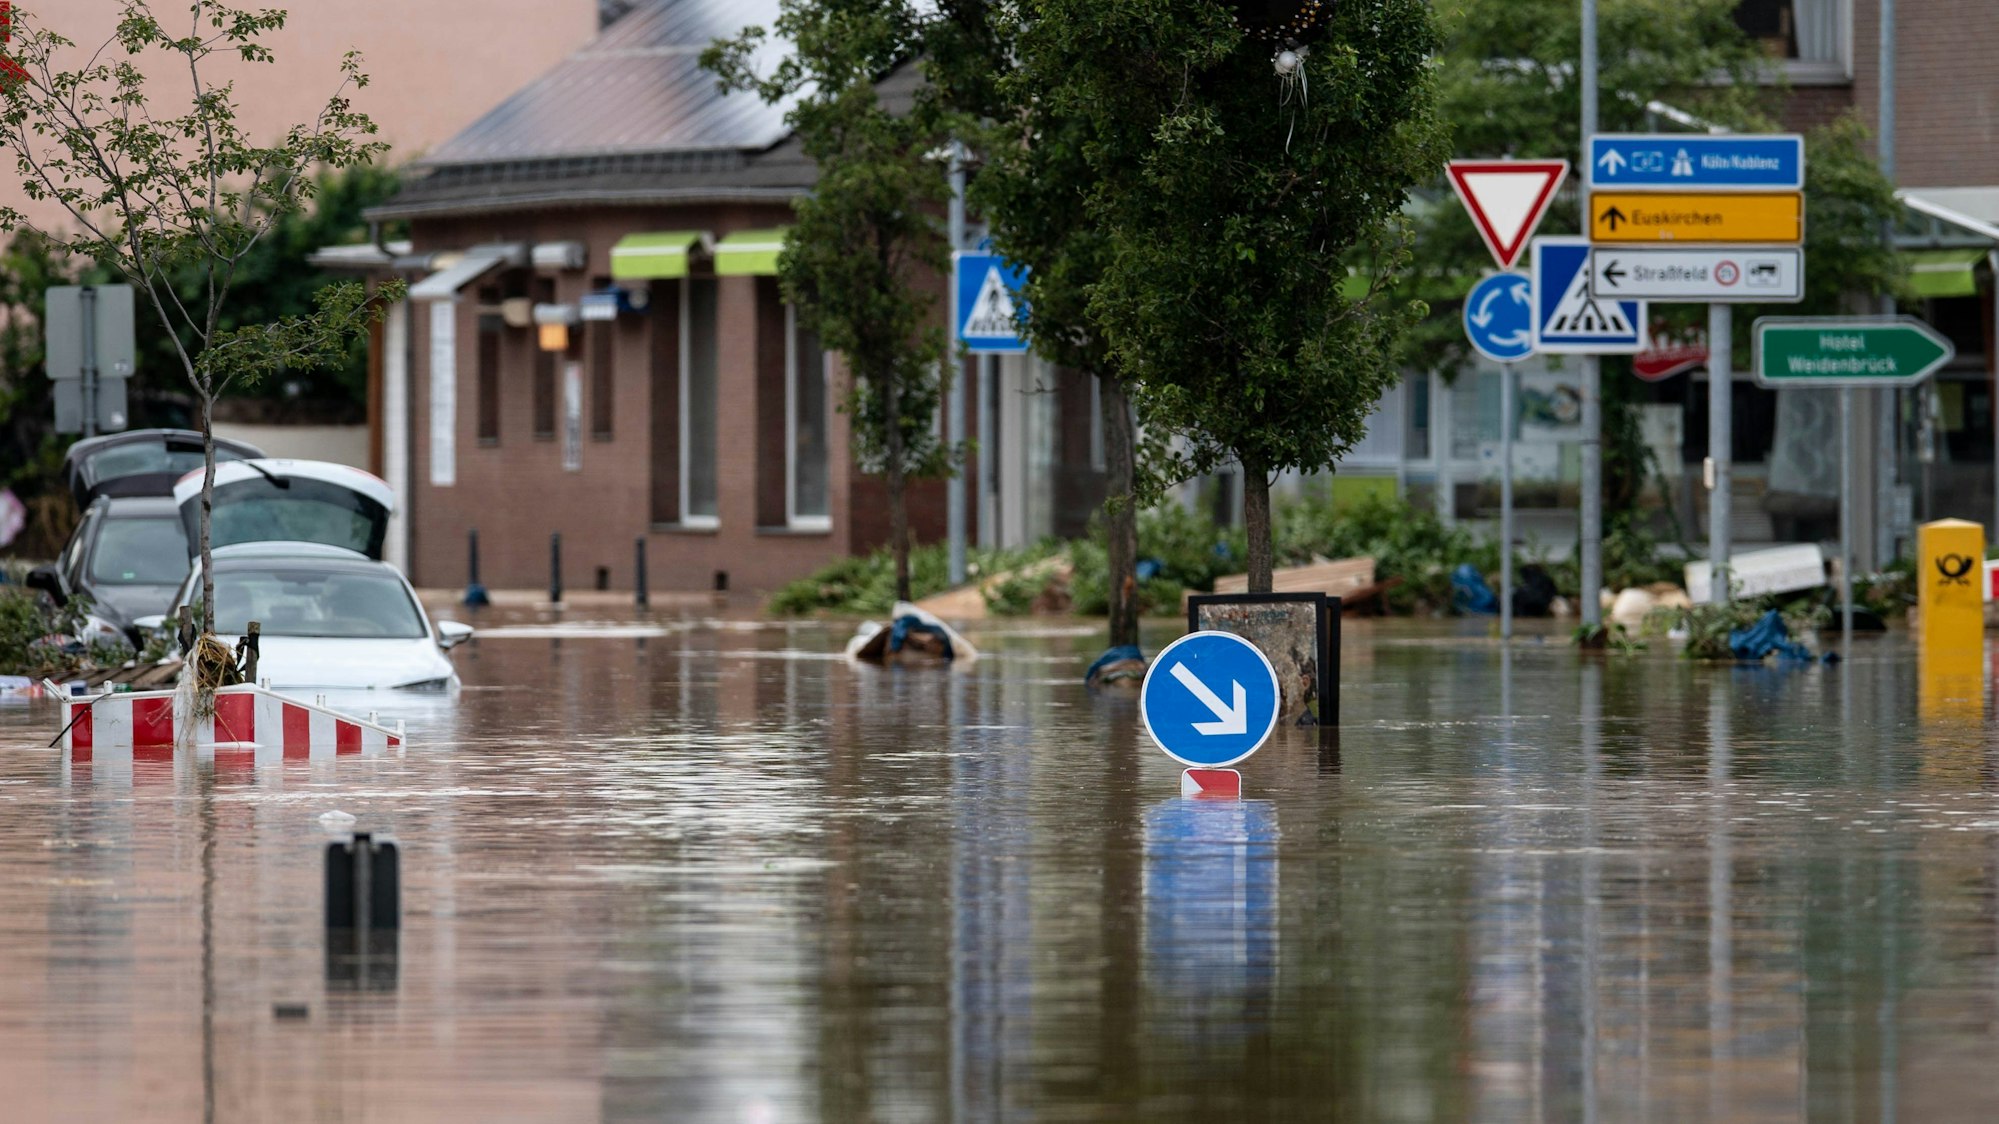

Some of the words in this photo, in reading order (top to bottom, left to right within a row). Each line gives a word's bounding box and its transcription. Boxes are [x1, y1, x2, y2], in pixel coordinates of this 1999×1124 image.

[1631, 209, 1723, 225] Euskirchen
[1633, 265, 1708, 281] Straßfeld
[1818, 332, 1865, 351] Hotel
[1787, 354, 1897, 374] Weidenbrück
